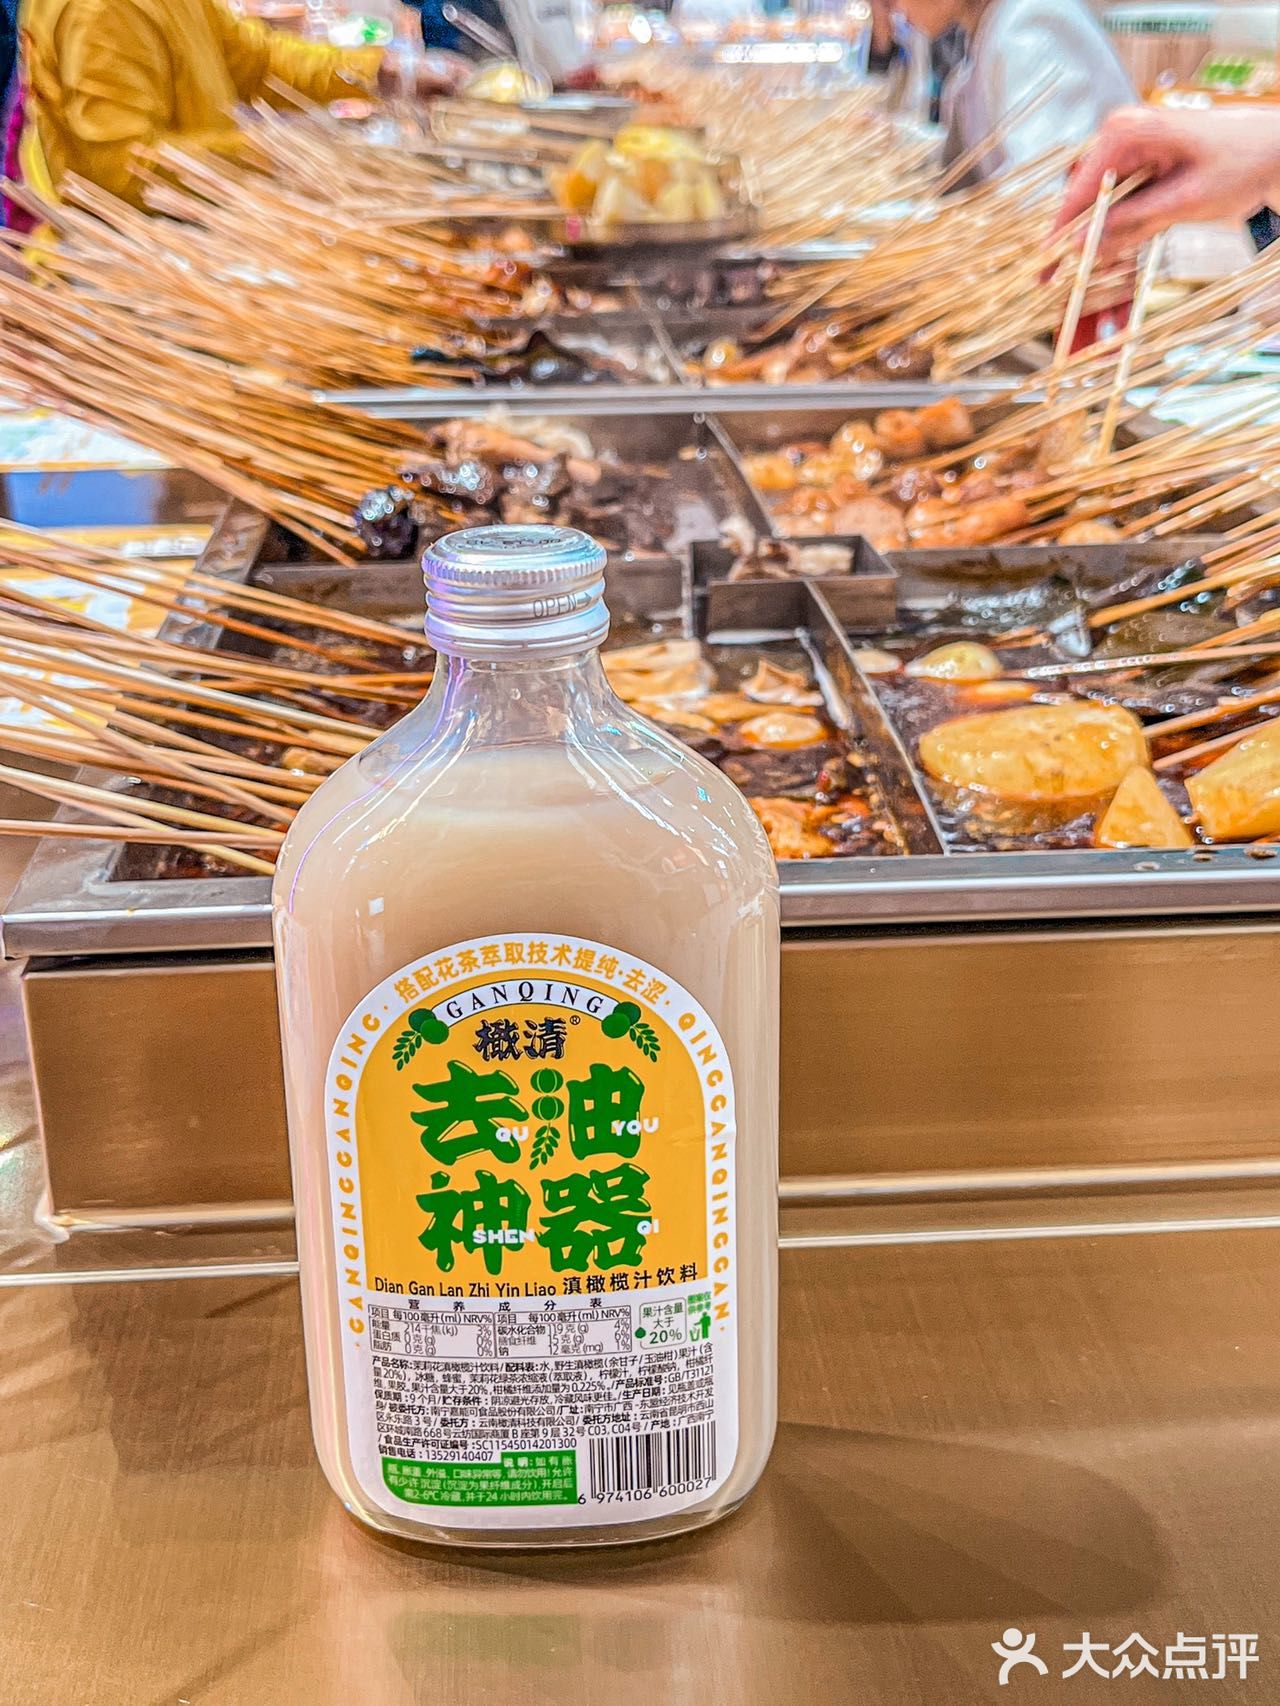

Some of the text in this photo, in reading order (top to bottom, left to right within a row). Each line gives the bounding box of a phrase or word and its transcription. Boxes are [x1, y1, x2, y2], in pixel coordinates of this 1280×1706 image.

[533, 593, 577, 617] OPEN
[446, 981, 604, 1019] GANQING
[496, 1117, 660, 1142] QU YOU
[415, 1162, 652, 1276] 神器
[472, 1219, 660, 1245] SHEN QI
[374, 1263, 698, 1298] Dian Gan Lan Zhi Yin Liao 滇橄榄汁饮料
[497, 1313, 517, 1325] 项目
[642, 1302, 684, 1319] 果汁含量
[653, 1316, 674, 1330] 大于
[649, 1327, 683, 1345] 20%
[578, 1477, 712, 1505] 6 974106 600027
